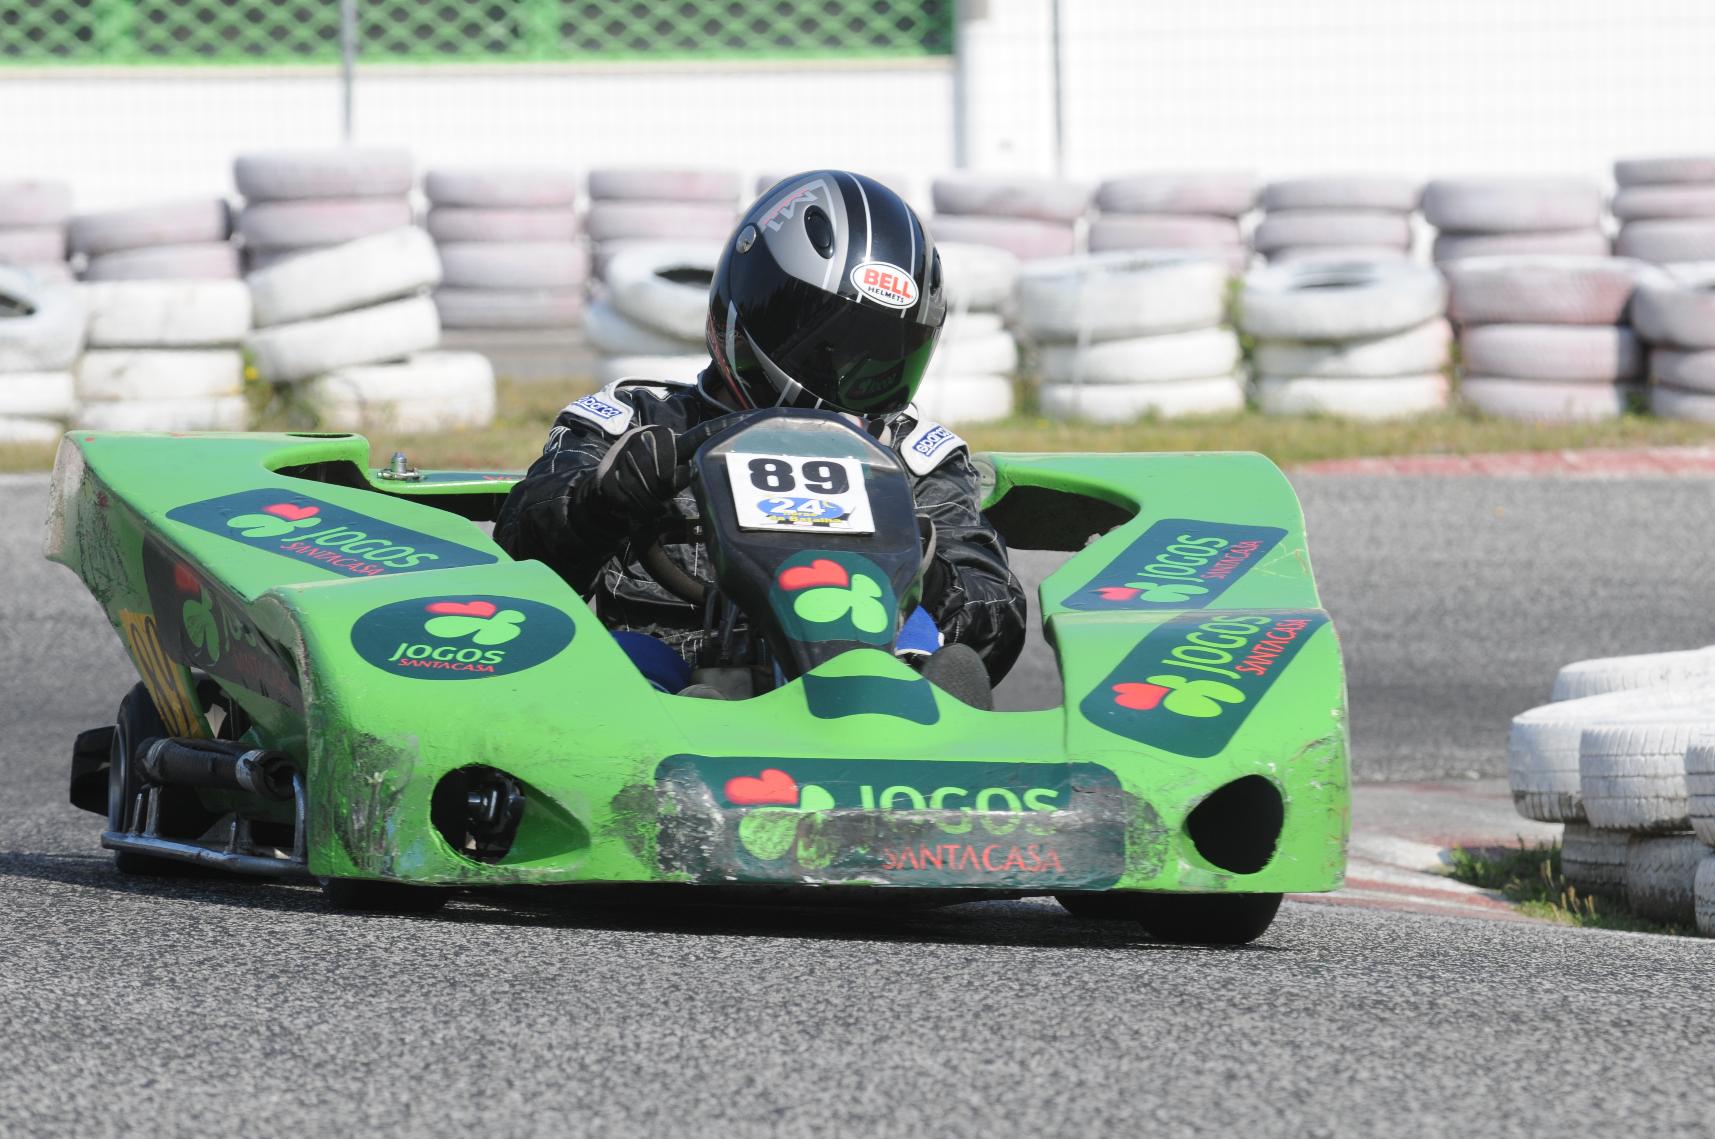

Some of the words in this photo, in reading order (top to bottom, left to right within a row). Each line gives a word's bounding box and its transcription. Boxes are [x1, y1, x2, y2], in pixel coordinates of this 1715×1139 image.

[864, 268, 911, 298] BELL
[868, 286, 904, 303] HELMETS
[748, 458, 849, 494] 89
[769, 499, 826, 515] 24
[280, 542, 385, 576] SANTACASA
[281, 526, 439, 568] JOGOS
[1137, 534, 1229, 582] JOGOS
[1201, 539, 1264, 580] SANTACASA
[388, 642, 506, 665] JOGOS
[1161, 616, 1272, 679] JOGOS
[1235, 619, 1312, 676] SANTACASA
[398, 658, 495, 673] SANTACASA
[881, 842, 1065, 873] SANTACASA
